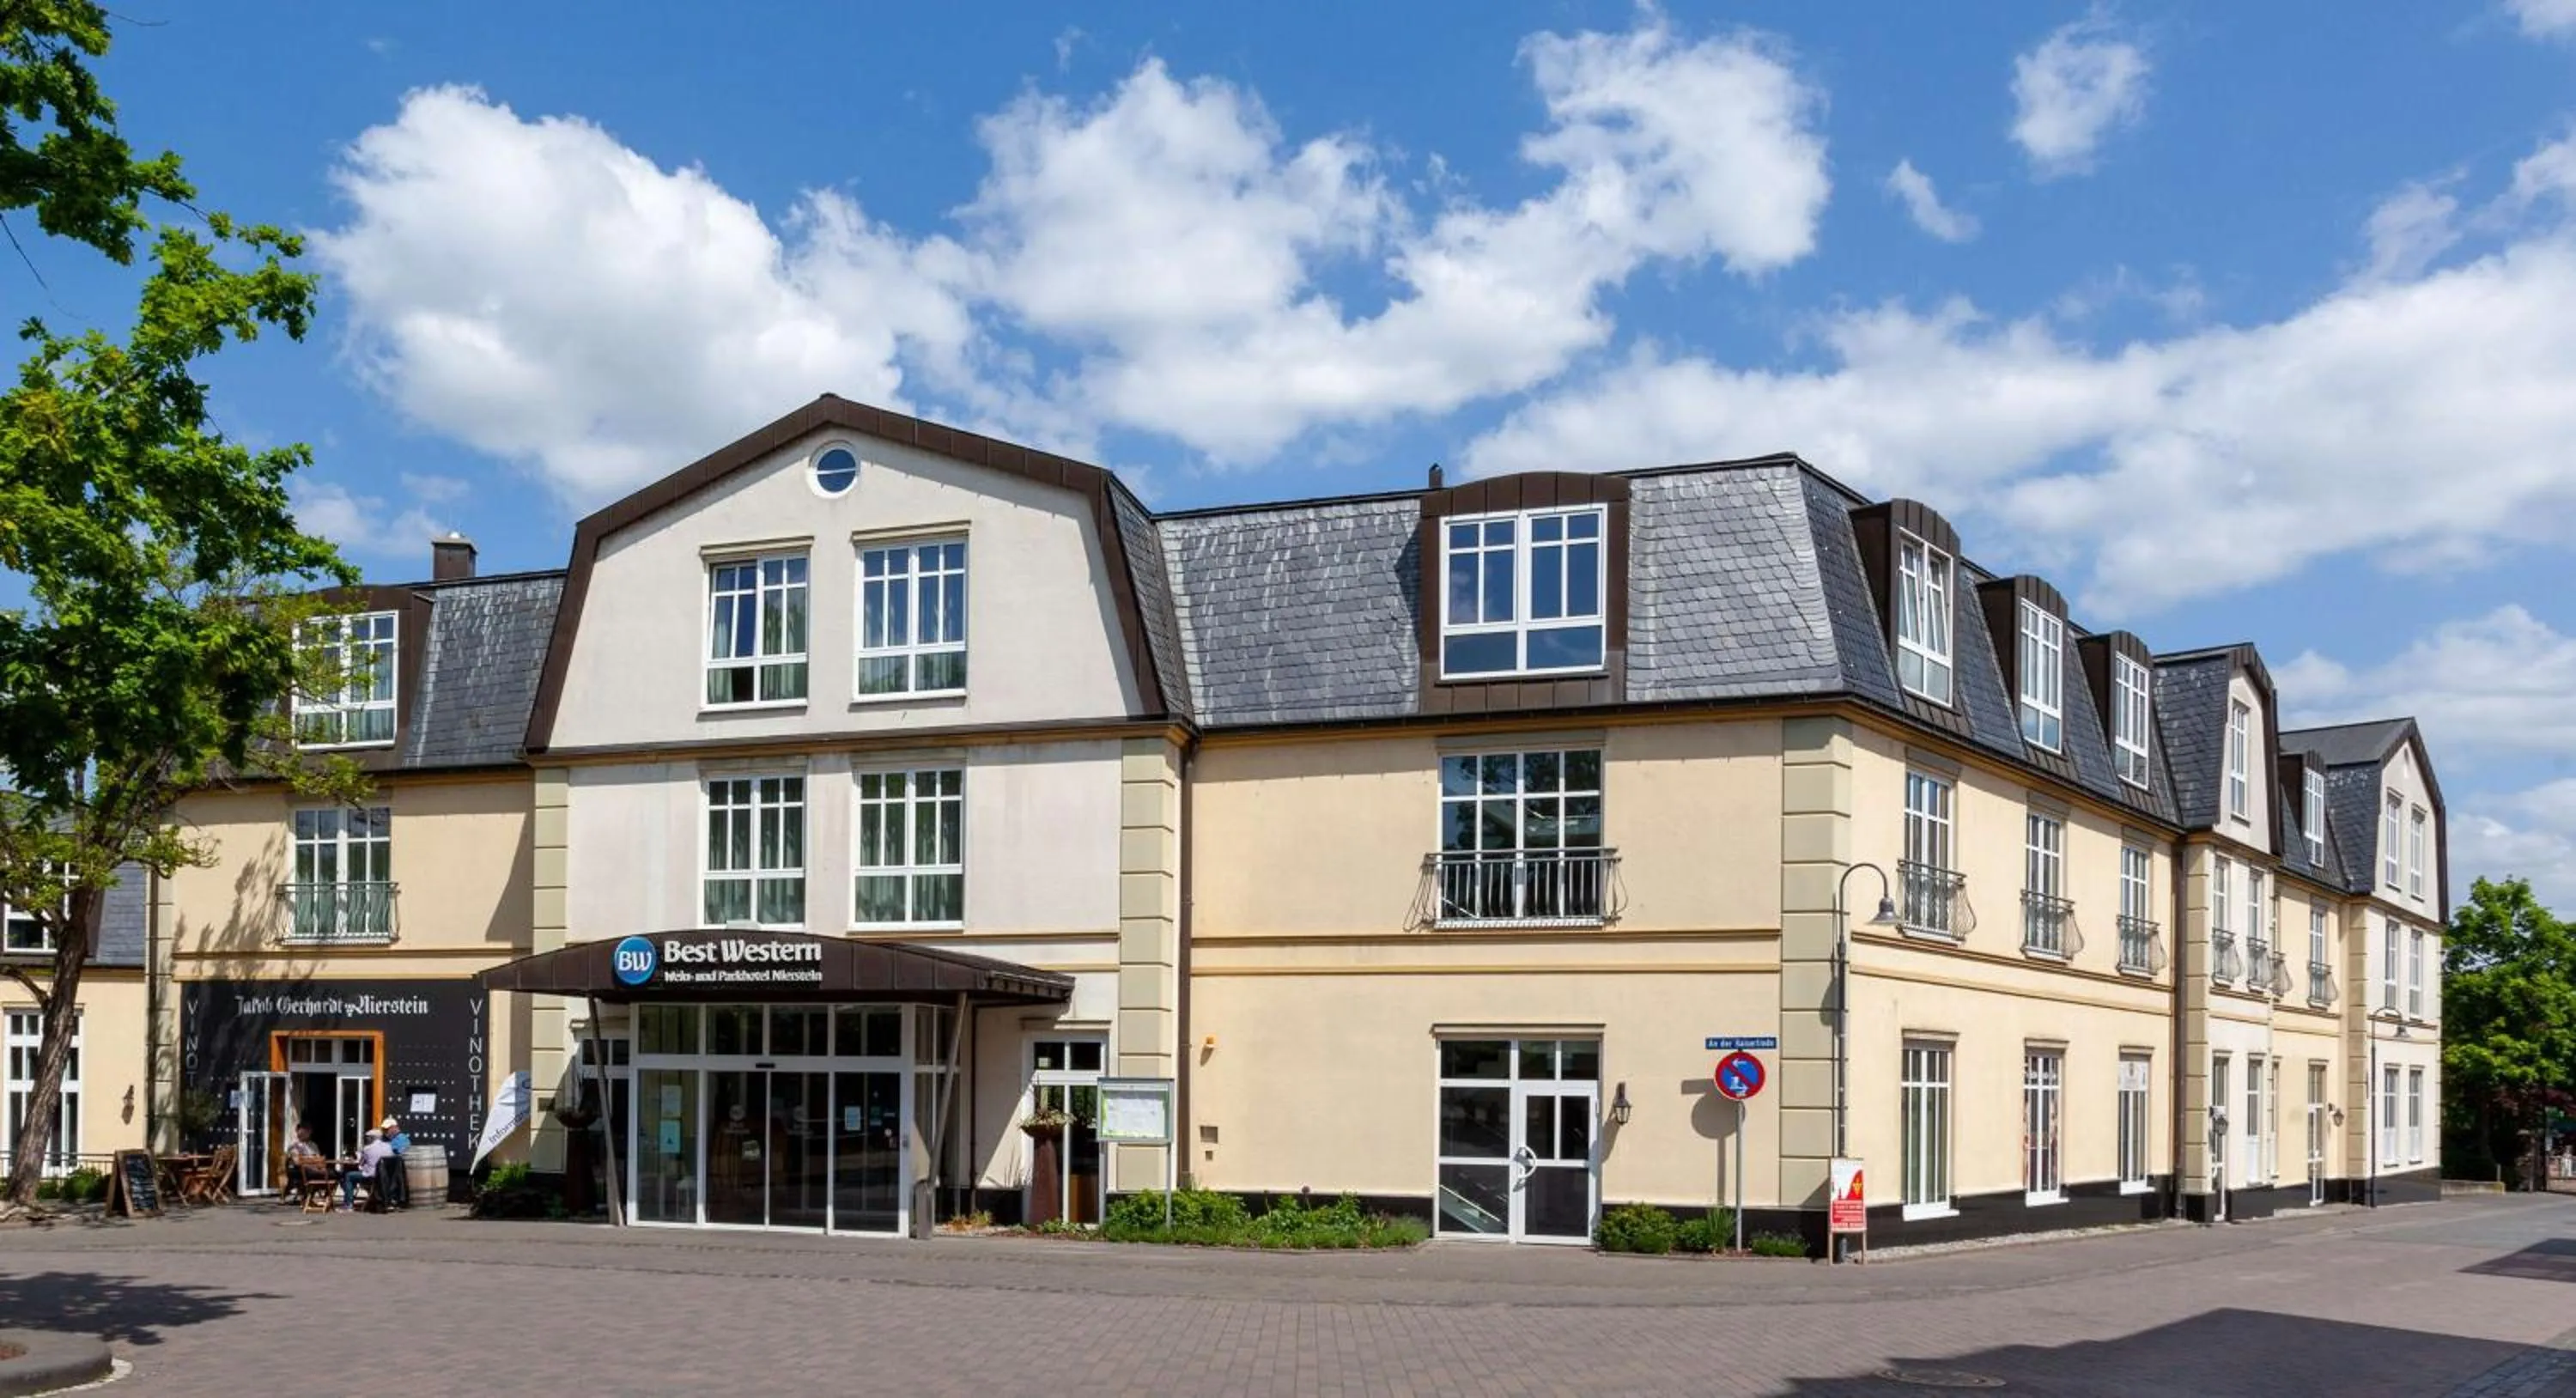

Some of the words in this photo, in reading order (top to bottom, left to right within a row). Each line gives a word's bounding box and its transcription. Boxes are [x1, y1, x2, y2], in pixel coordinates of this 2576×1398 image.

[618, 951, 652, 971] BW
[664, 940, 717, 963] Best
[720, 939, 822, 963] Western
[664, 969, 695, 982] Wein-
[696, 969, 717, 982] und
[719, 969, 770, 982] Parkhotel
[772, 969, 822, 982] Nierstein
[234, 994, 272, 1016] Jakob
[276, 994, 343, 1018] Gerhardt
[356, 994, 428, 1015] Nierstein
[468, 997, 483, 1150] VINOTHEK
